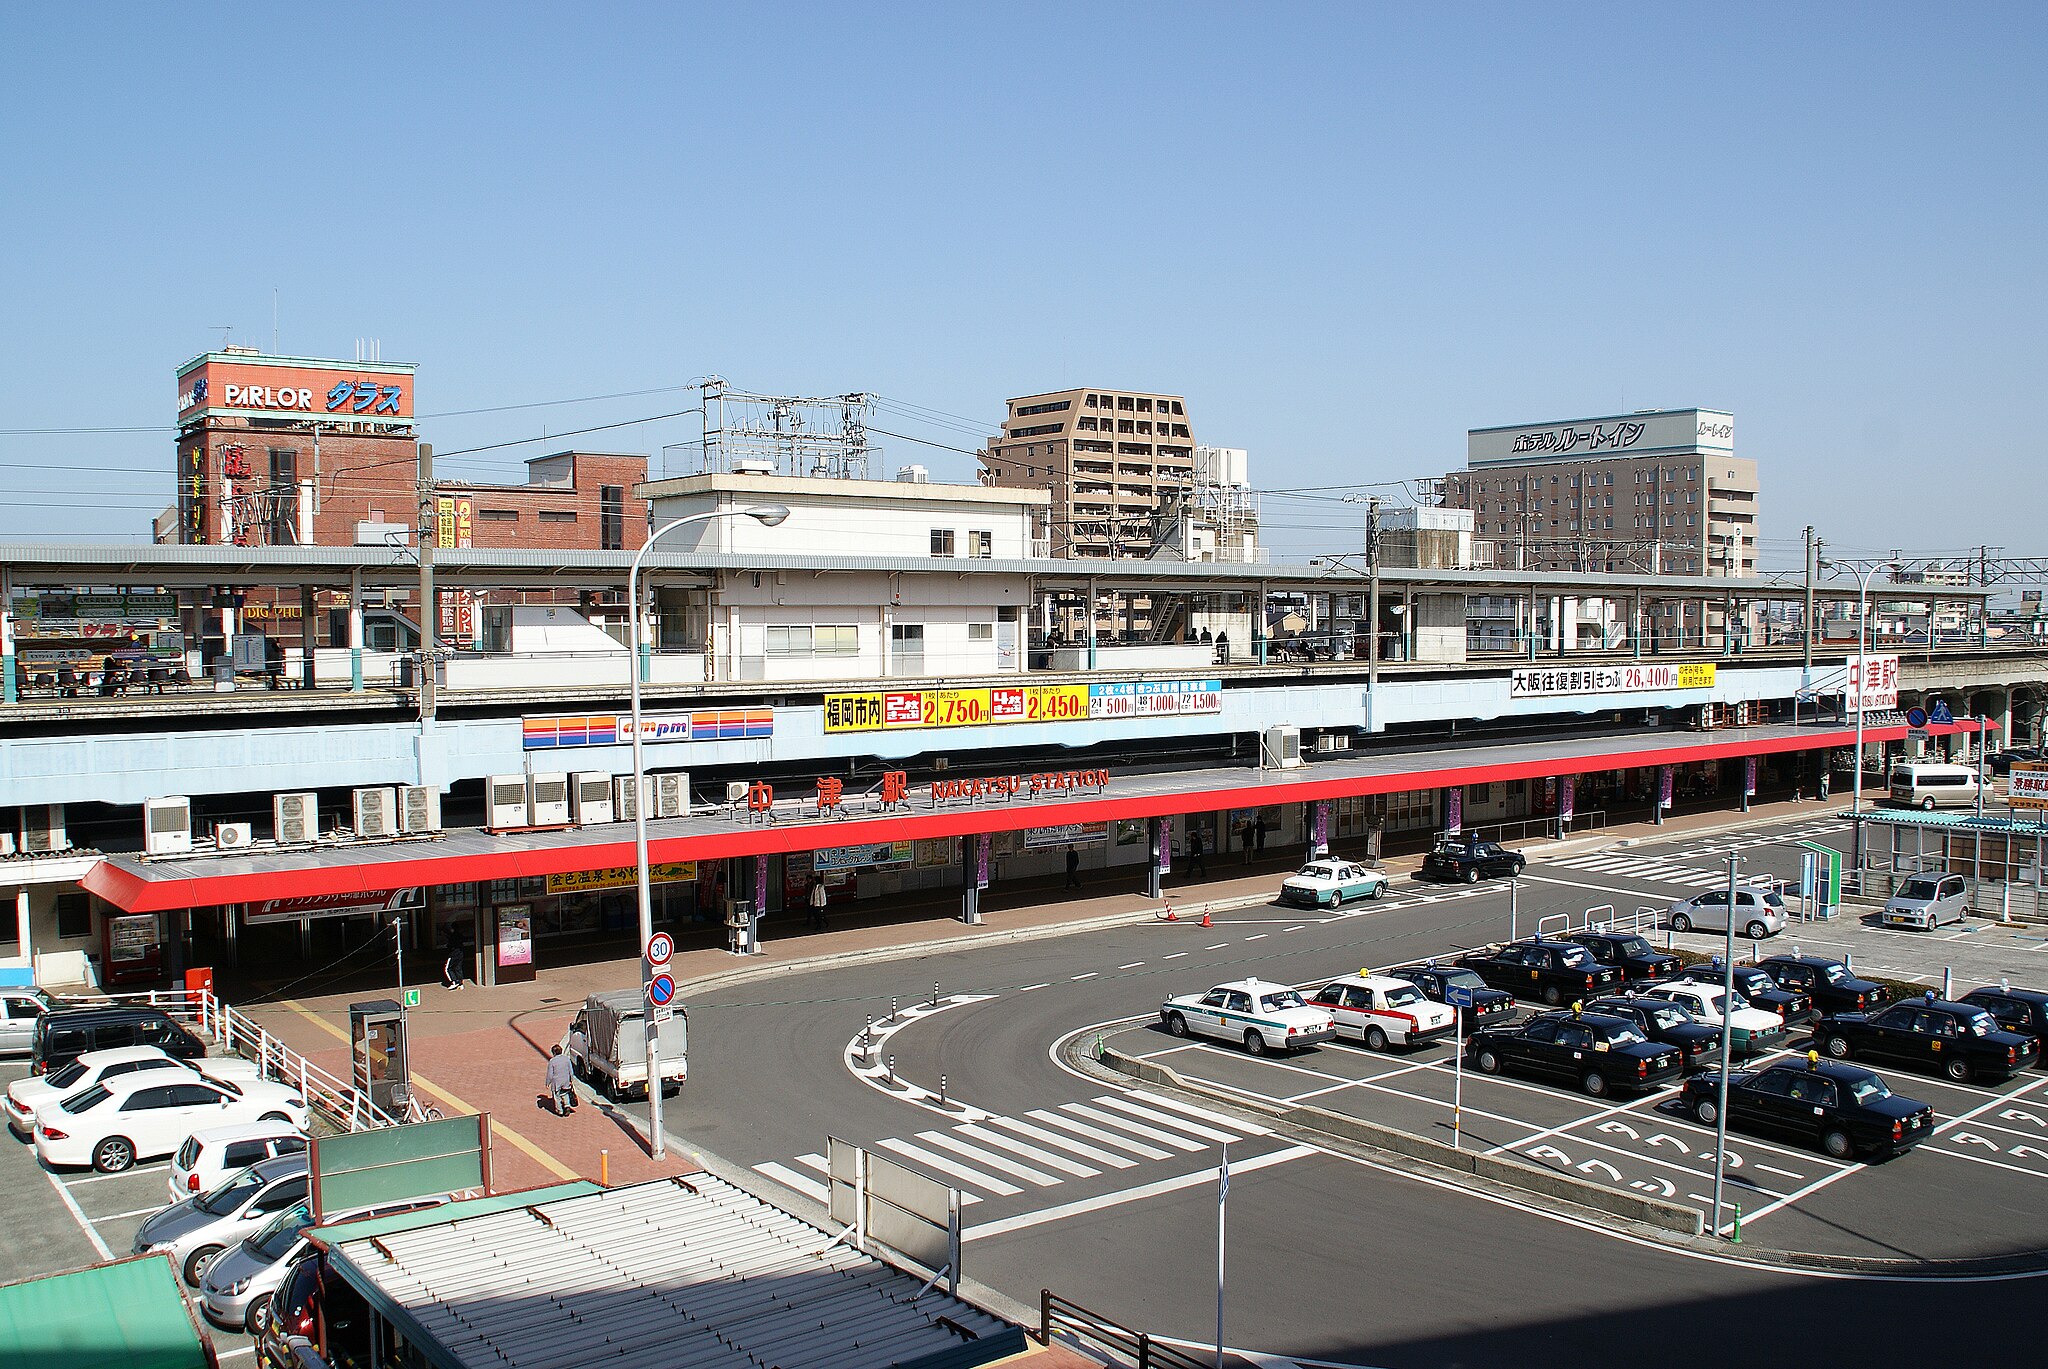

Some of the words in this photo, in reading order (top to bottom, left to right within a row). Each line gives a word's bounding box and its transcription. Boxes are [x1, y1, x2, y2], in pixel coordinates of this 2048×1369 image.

[225, 385, 312, 408] PARLOR
[326, 380, 402, 412] ダラス
[1512, 423, 1645, 452] ホテルルートイン
[1513, 671, 1620, 692] 大阪往復割引きっぷ
[1626, 667, 1678, 688] 26,400円
[1849, 659, 1897, 692] 中津駅
[1028, 695, 1087, 718] 2,450円
[1107, 697, 1134, 714] 500円
[1137, 696, 1147, 705] 48
[1149, 695, 1179, 711] 1,000円
[1182, 694, 1191, 703] 72
[1193, 693, 1221, 709] 1,500円
[827, 697, 881, 727] 福岡市内
[886, 710, 919, 720] きっぷ
[923, 700, 989, 723] 2,750円
[748, 771, 910, 813] 中津駅
[932, 775, 1020, 799] NAKATSU
[1030, 769, 1109, 791] STATION
[551, 870, 606, 887] 金色温泉
[652, 941, 668, 957] 30
[1525, 1144, 1737, 1210] タクシー
